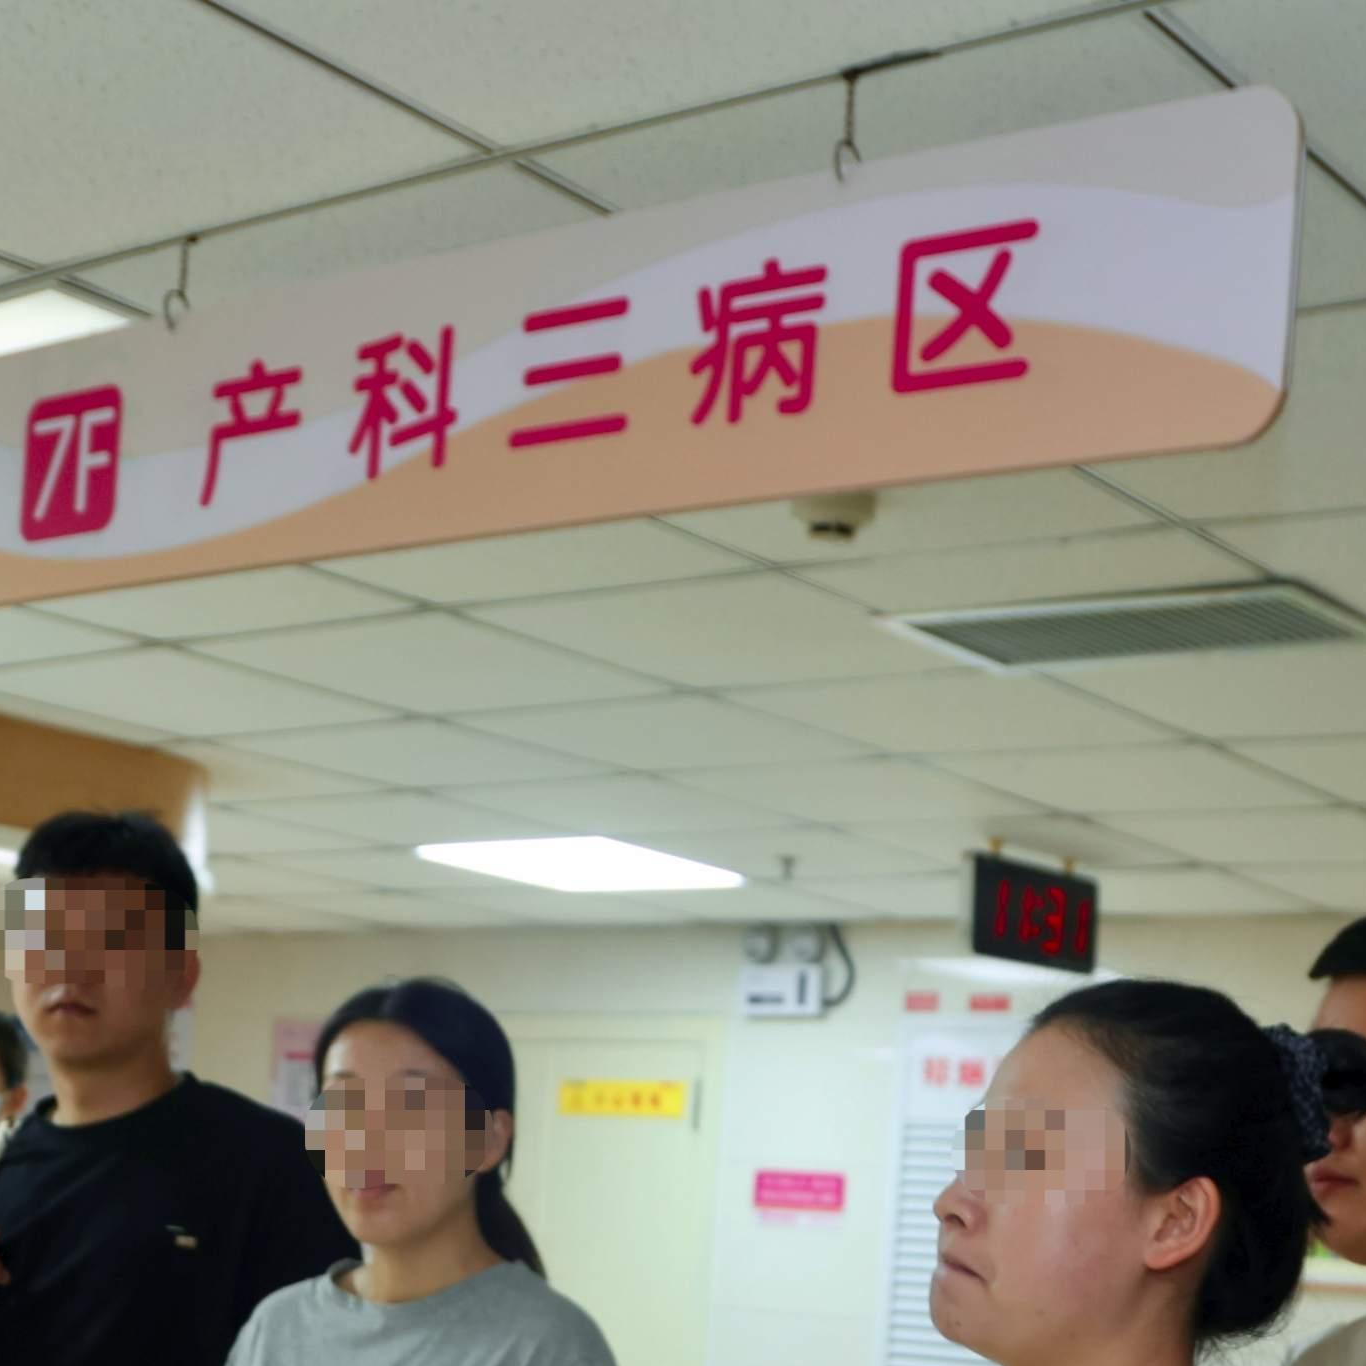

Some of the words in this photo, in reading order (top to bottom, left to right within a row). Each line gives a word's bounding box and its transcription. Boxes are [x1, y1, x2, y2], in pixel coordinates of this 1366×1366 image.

[32, 405, 117, 520] 7F
[201, 219, 1040, 506] 产科三病区
